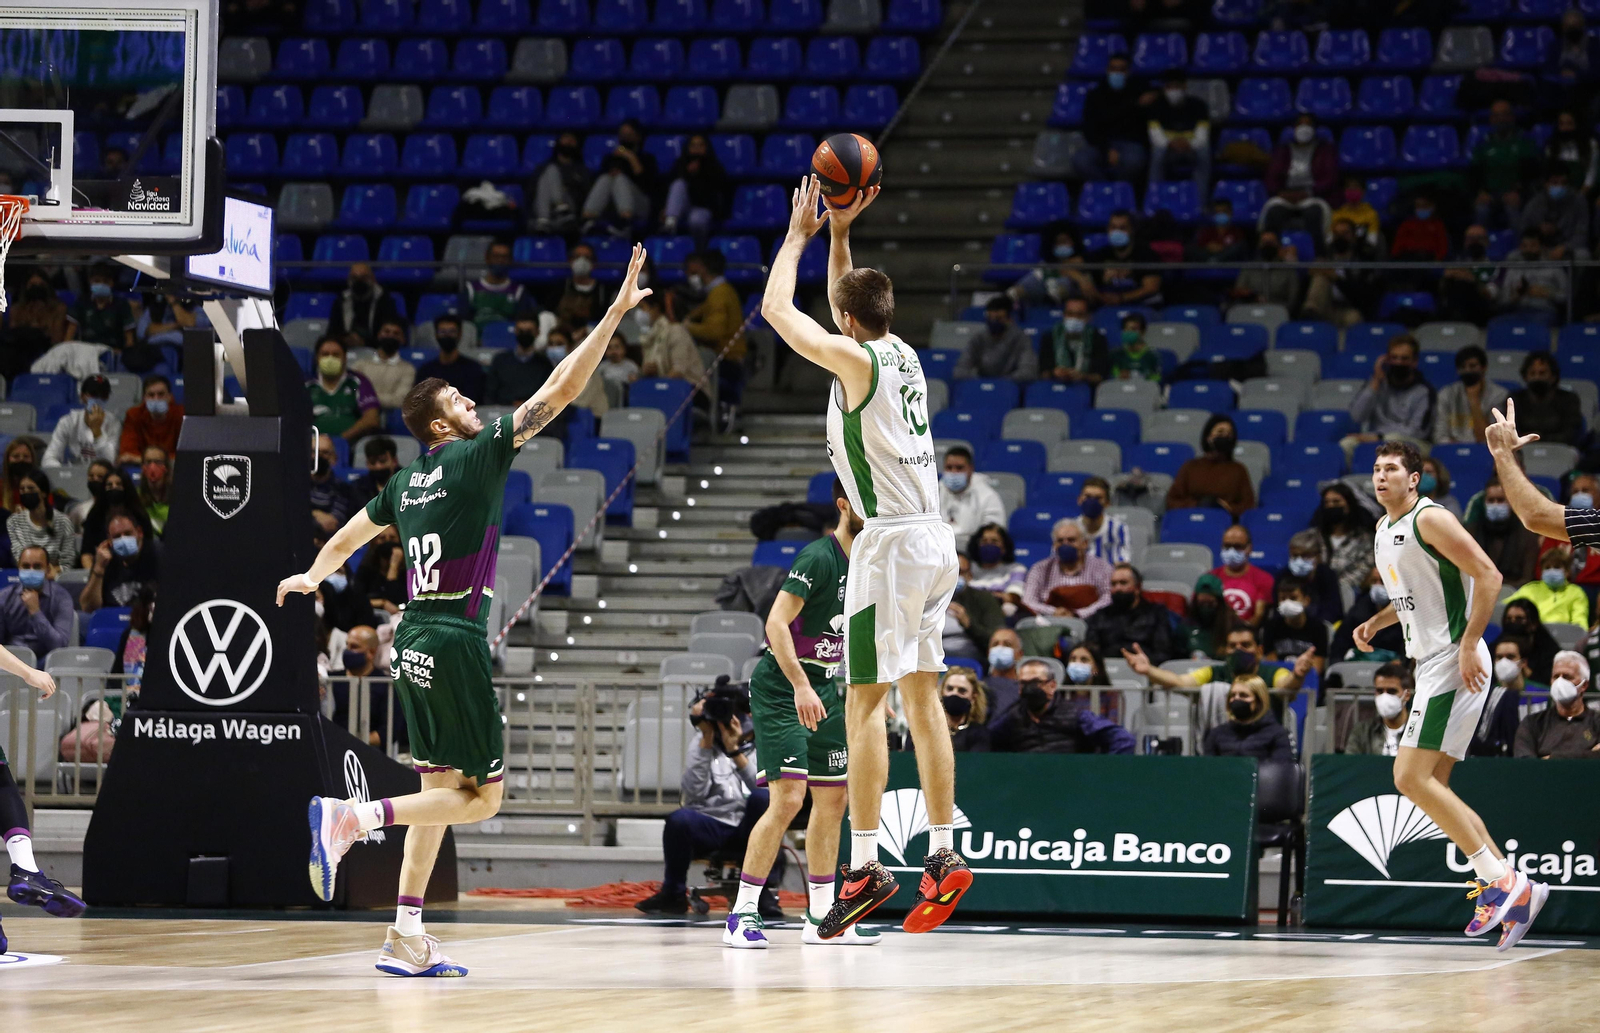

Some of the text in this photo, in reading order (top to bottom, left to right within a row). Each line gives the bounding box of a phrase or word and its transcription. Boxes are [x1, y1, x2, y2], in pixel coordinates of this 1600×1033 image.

[127, 201, 170, 211] Navidad
[408, 533, 442, 596] 32
[401, 648, 435, 668] COSTA
[413, 665, 433, 679] SOL
[134, 717, 301, 746] Málaga Wagen
[961, 827, 1231, 869] Unicaja Banco
[1446, 838, 1598, 884] Uicaja
